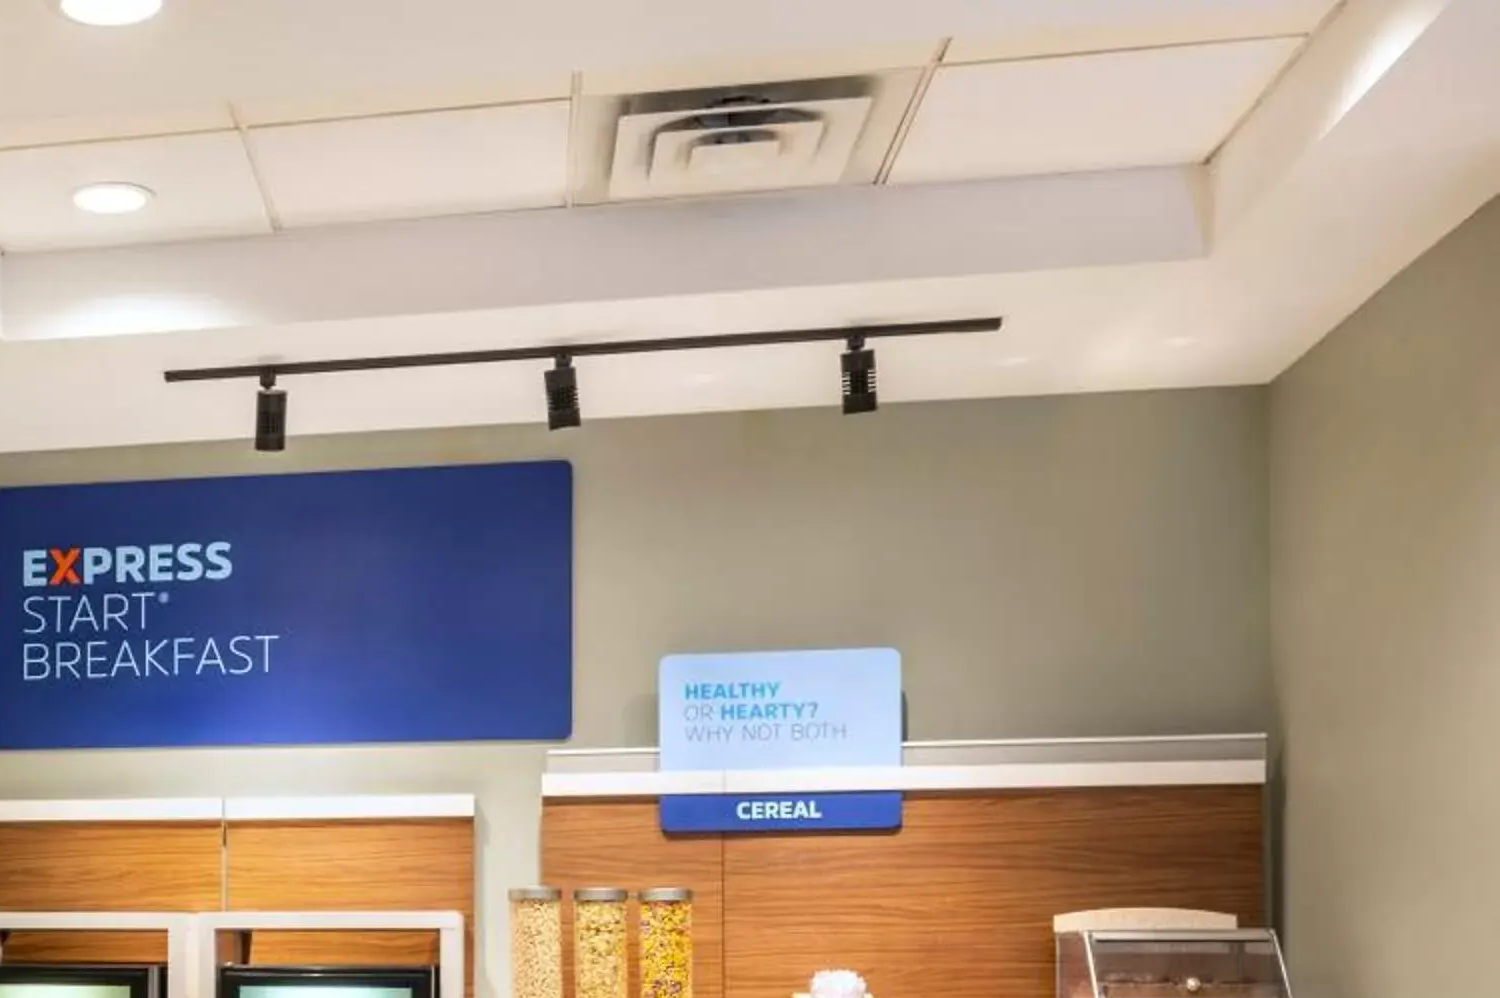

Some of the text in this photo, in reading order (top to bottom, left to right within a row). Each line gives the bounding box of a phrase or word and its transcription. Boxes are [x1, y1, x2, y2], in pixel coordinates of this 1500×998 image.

[23, 541, 233, 587] EXPRESS
[23, 635, 280, 680] BREAKFAST
[684, 682, 781, 700] HEALTHY
[684, 702, 819, 721] OR HEARTY?
[685, 721, 847, 742] WHY NOT BOTH
[736, 801, 823, 820] CEREAL
